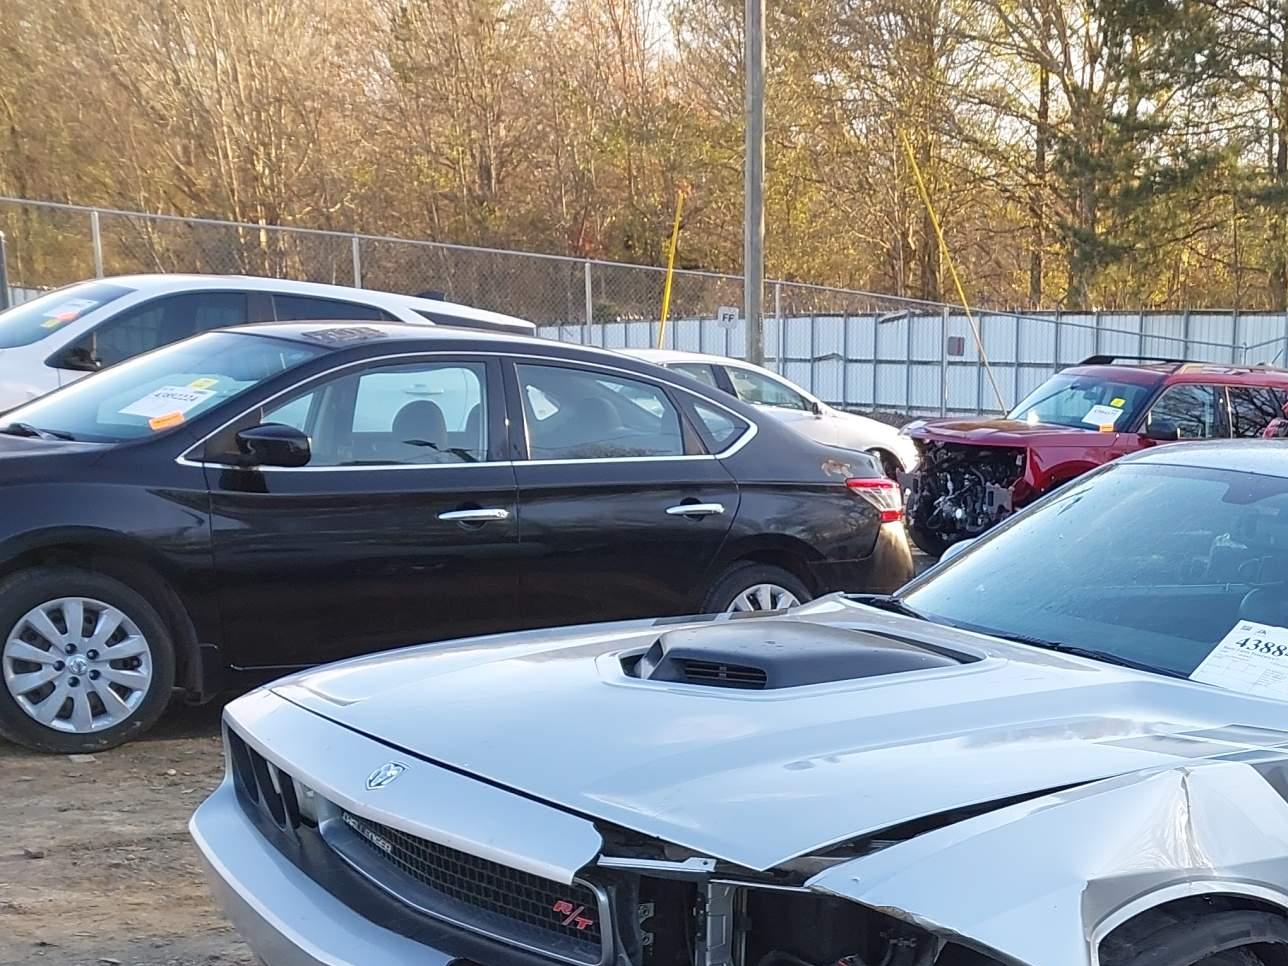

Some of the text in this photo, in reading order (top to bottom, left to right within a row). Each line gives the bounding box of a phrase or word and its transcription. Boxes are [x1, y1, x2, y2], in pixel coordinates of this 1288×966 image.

[722, 313, 735, 322] FF
[342, 811, 392, 854] CHALLENGER
[552, 900, 593, 930] R/T
